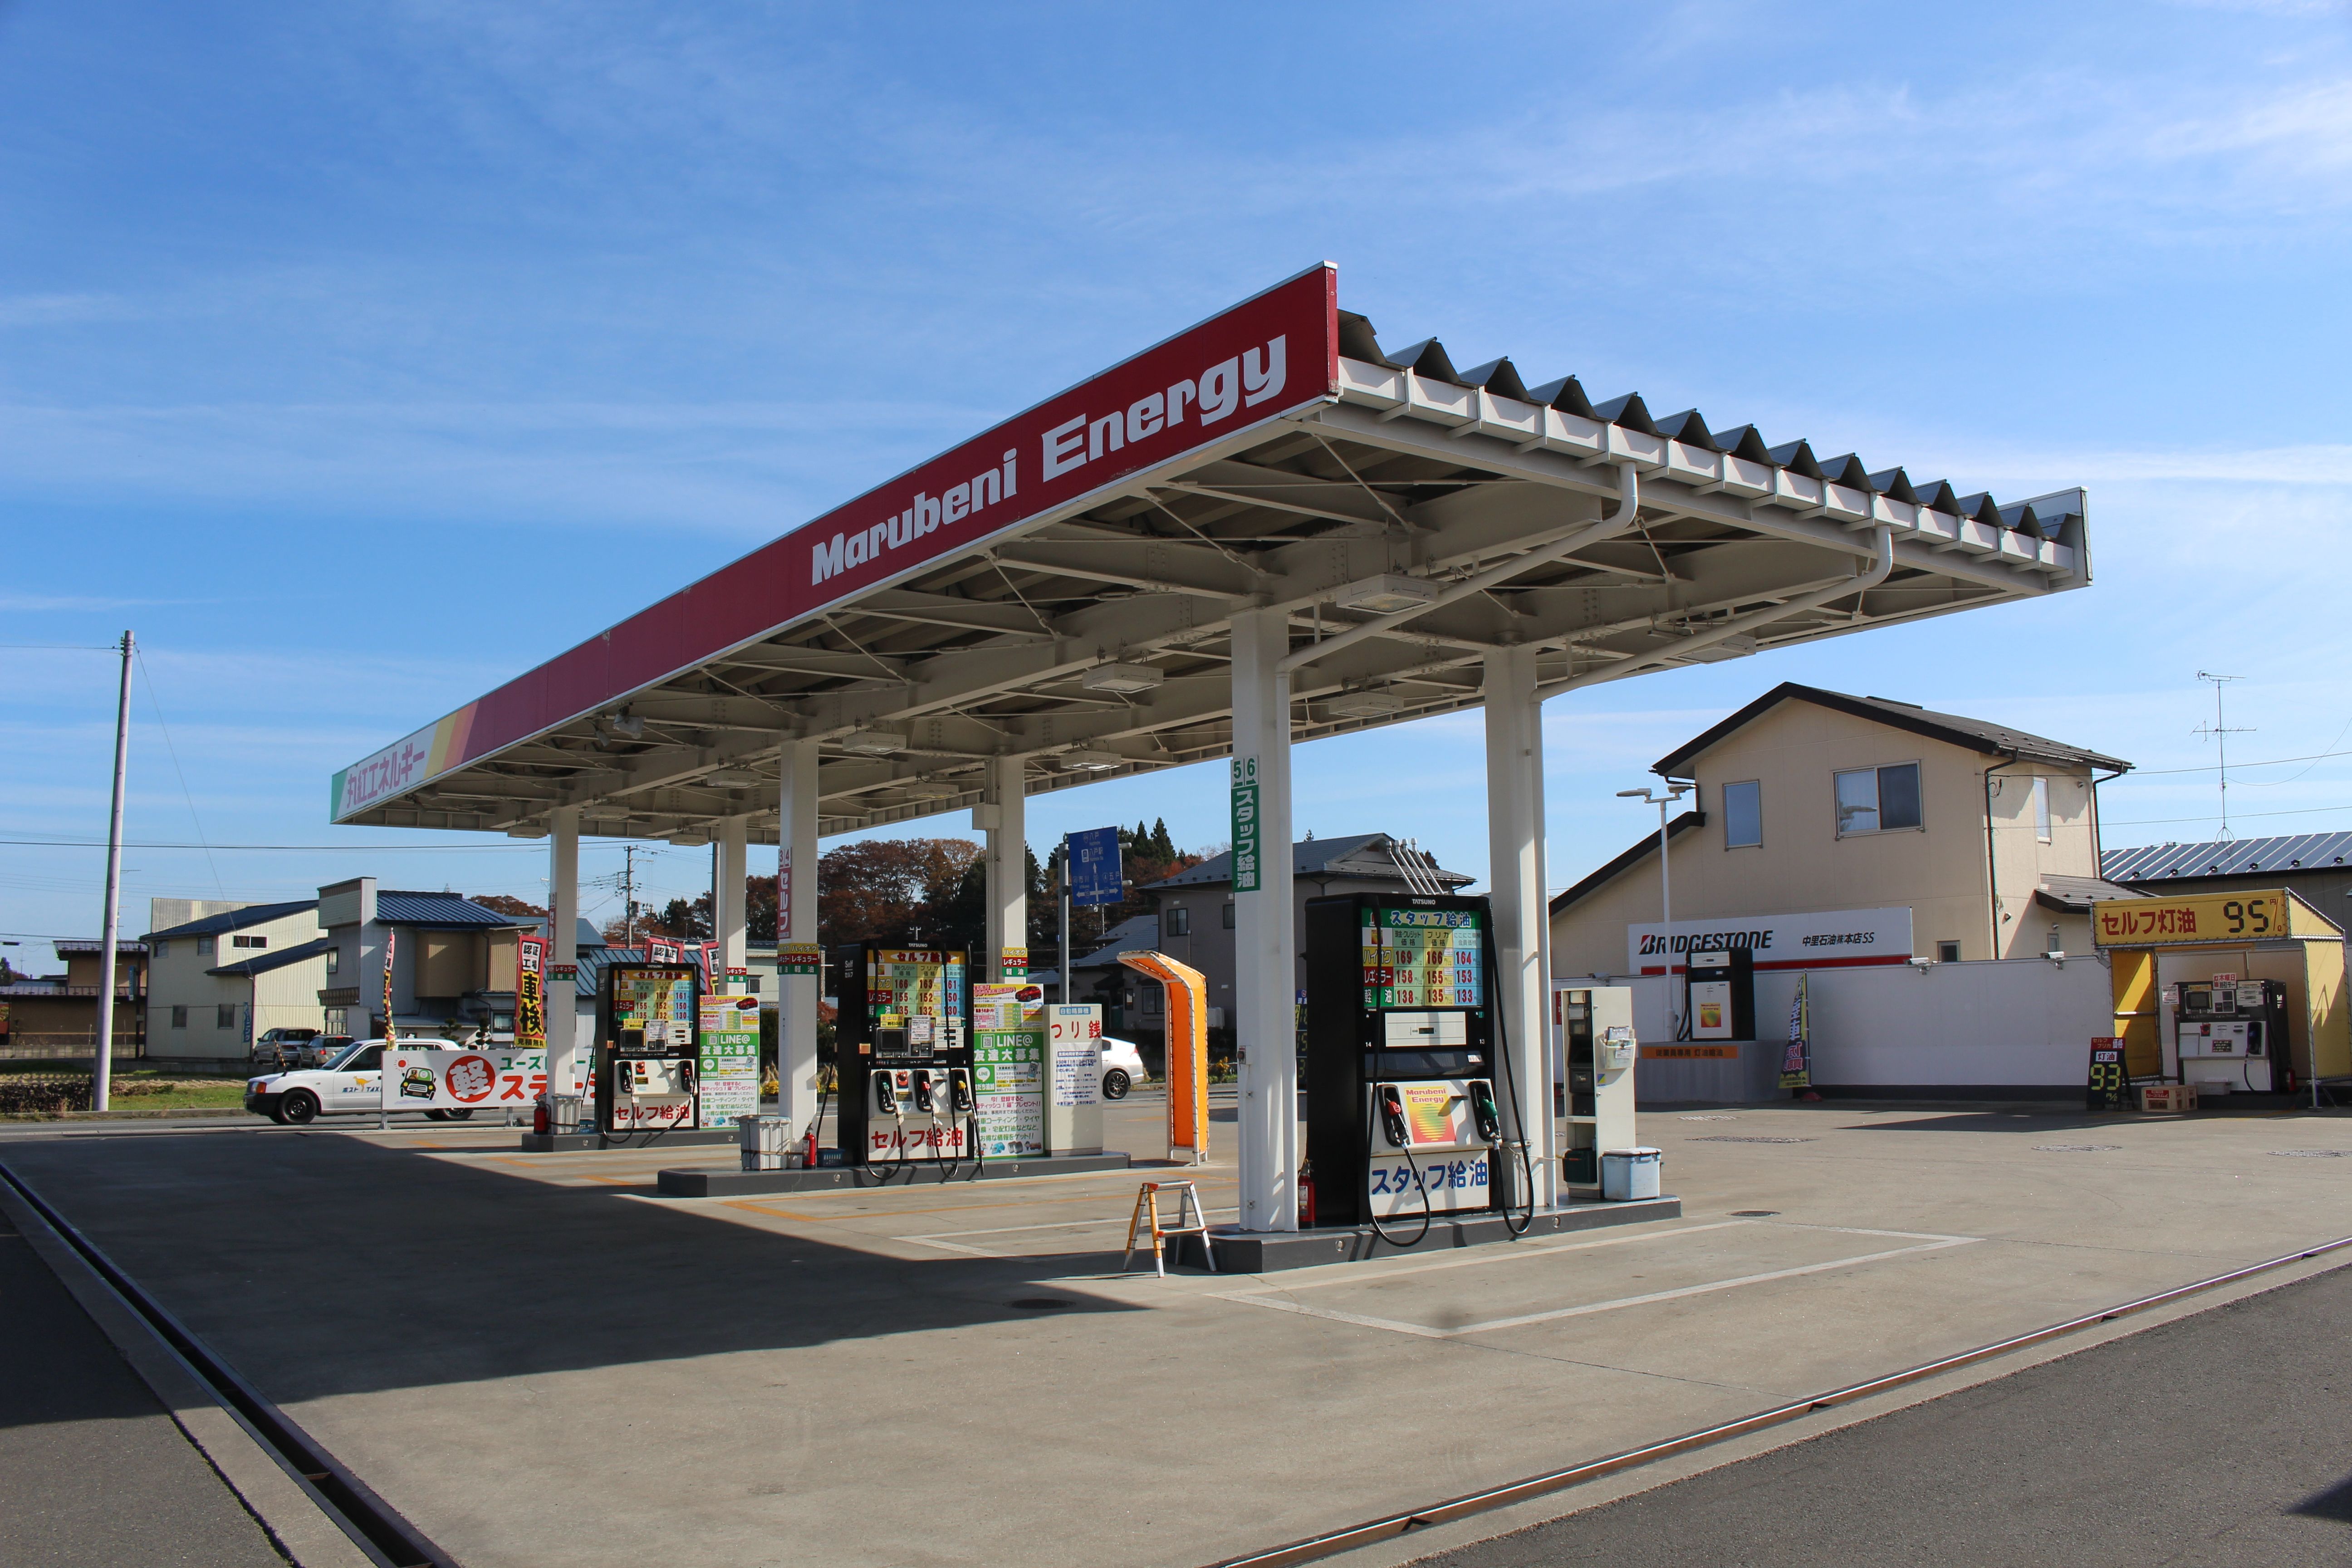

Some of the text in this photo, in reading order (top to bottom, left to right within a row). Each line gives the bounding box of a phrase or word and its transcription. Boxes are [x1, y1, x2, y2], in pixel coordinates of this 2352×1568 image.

[812, 334, 1286, 586] Marubeni Energy
[347, 742, 425, 809] 丸紅エネルギー
[1234, 758, 1255, 779] 5 6
[1236, 789, 1255, 888] スタッフ給油
[785, 849, 789, 861] 4
[780, 871, 788, 931] セルフ
[1391, 911, 1471, 927] スタッフ給油
[2102, 908, 2197, 936] セルフ灯油
[2223, 900, 2269, 933] 95
[1639, 930, 1773, 955] BRIDGESTONE
[523, 944, 538, 956] 認証
[1396, 950, 1412, 964] 169
[523, 958, 538, 970] 工場
[845, 960, 853, 968] Self
[1426, 951, 1442, 965] 166
[1456, 951, 1471, 965] 164
[638, 971, 682, 980] セルフ給油
[1396, 970, 1413, 983] 158
[1427, 970, 1443, 984] 155
[1456, 970, 1472, 983] 153
[895, 979, 908, 989] 166
[920, 980, 932, 989] 163
[945, 980, 957, 989] 61
[869, 992, 891, 1002] レュラー
[895, 993, 908, 1002] 155
[920, 993, 933, 1002] 152
[945, 993, 957, 1002] 50
[1364, 989, 1392, 1003] 軽油
[1397, 990, 1413, 1004] 138
[1427, 989, 1443, 1003] 135
[1457, 989, 1473, 1003] 133
[519, 974, 543, 1034] 車検
[895, 1005, 908, 1015] 135
[920, 1006, 933, 1015] 132
[1051, 1020, 1101, 1039] つり銭
[720, 1034, 750, 1044] LINE@
[997, 1034, 1033, 1047] LINE@
[2112, 1039, 2123, 1049] 価格
[701, 1045, 756, 1055] 友達大募集
[974, 1048, 1039, 1061] 友達大募集
[2097, 1052, 2115, 1061] 灯油
[450, 1059, 491, 1099] 軽
[2090, 1064, 2121, 1090] 93
[615, 1104, 690, 1121] セルフ給油
[978, 1125, 1039, 1133] 検・宅配灯油などなど。
[871, 1127, 963, 1149] セルフ給油
[1372, 1159, 1488, 1195] スタッフ給油
